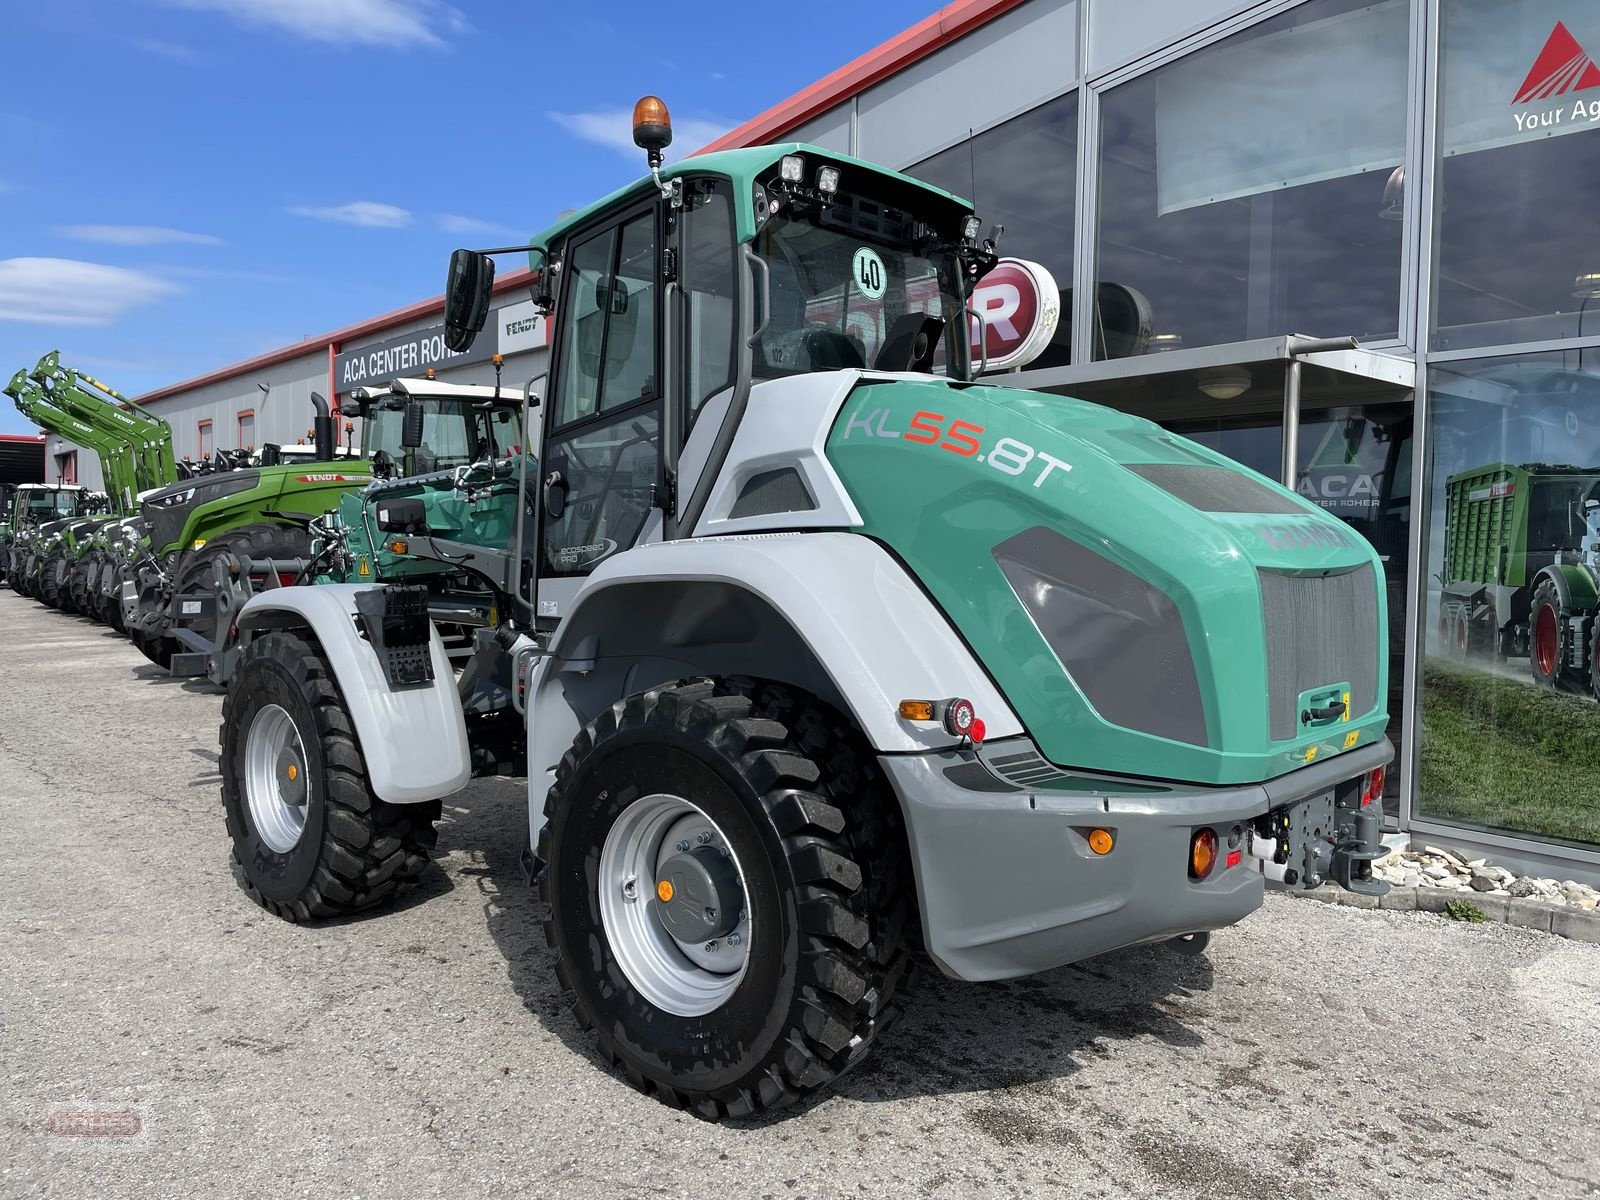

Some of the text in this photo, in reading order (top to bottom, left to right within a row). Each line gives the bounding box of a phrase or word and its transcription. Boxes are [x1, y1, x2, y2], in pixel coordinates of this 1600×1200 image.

[1513, 108, 1564, 132] Your
[860, 256, 881, 291] 40
[505, 316, 539, 336] FENDT
[343, 334, 470, 384] ACA CENTER ROH
[113, 412, 136, 425] FENDT
[305, 474, 338, 482] FENDT
[1296, 474, 1380, 498] ACA
[1314, 500, 1380, 508] TER ROHER
[561, 543, 604, 555] ecospeed
[561, 555, 578, 563] PRO
